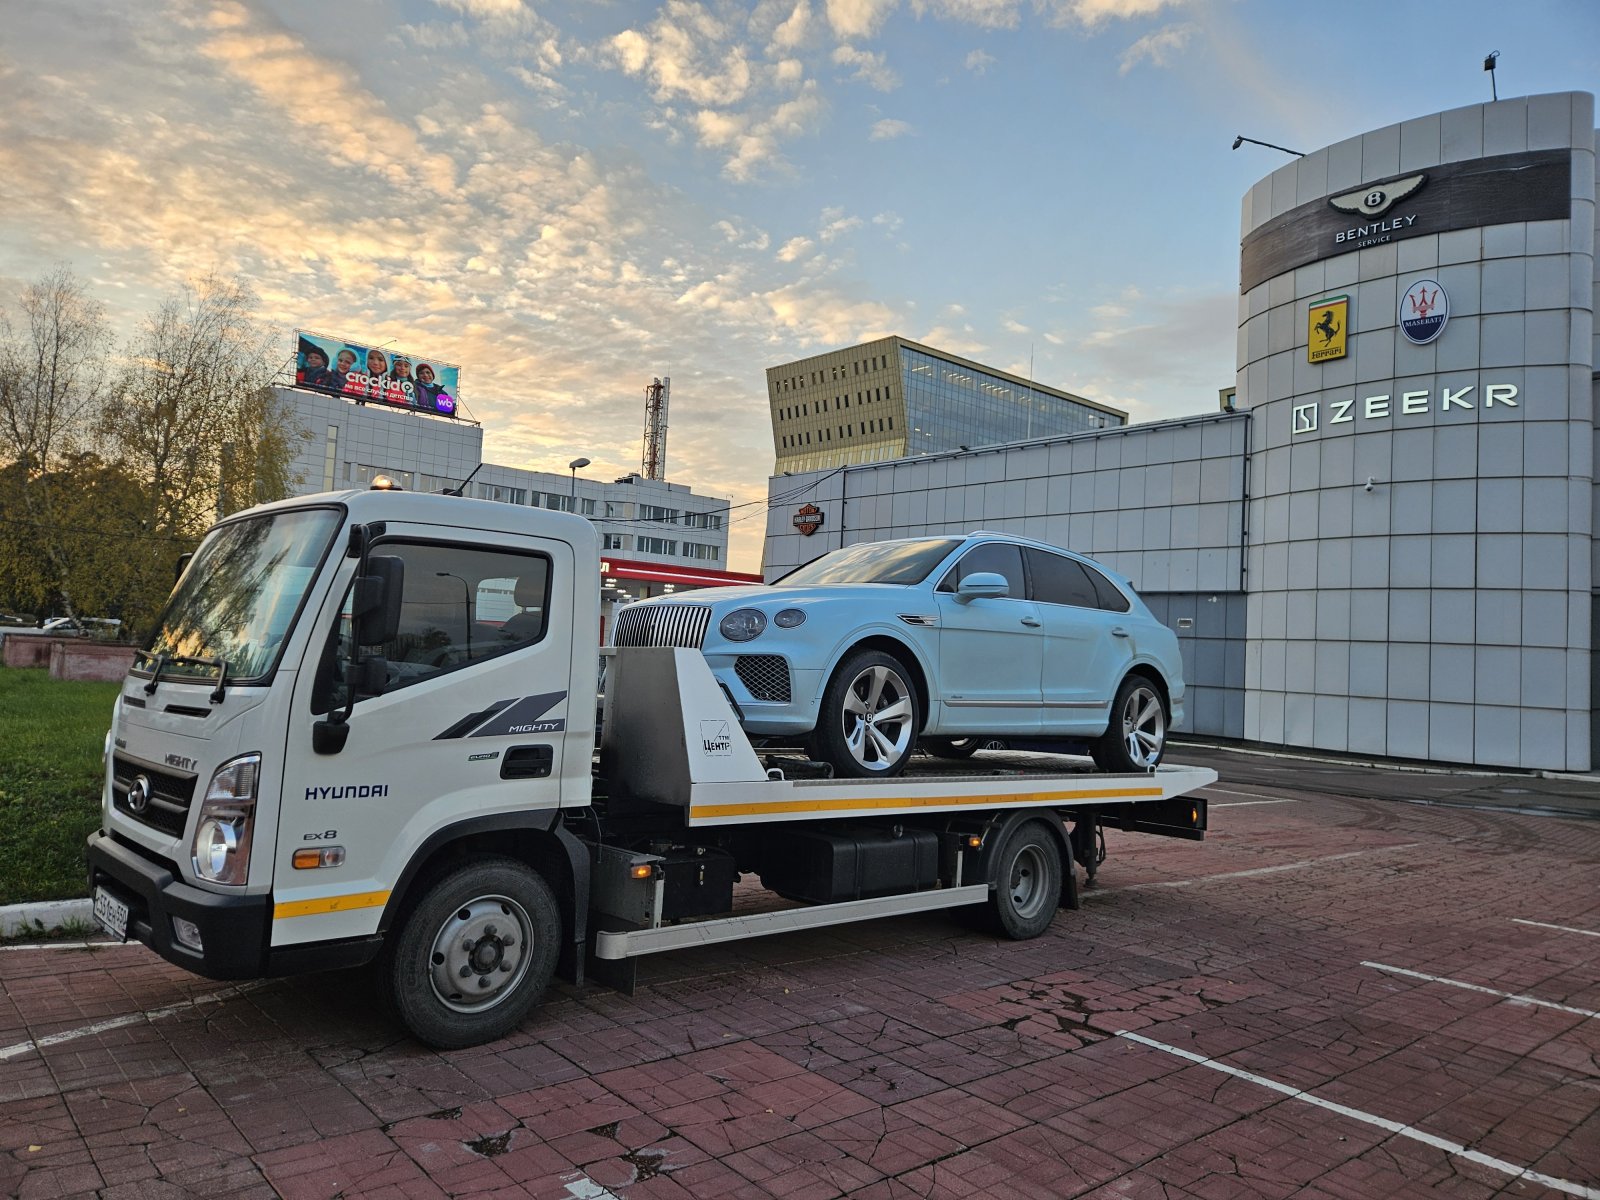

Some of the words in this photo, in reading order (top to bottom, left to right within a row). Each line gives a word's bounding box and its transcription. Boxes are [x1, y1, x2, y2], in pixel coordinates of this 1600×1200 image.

[1335, 214, 1418, 244] BENTLEY
[1357, 235, 1392, 248] SERVICE
[1405, 316, 1443, 328] MASERATI
[1311, 346, 1343, 360] Ferrari
[437, 397, 453, 409] wb
[1329, 383, 1519, 425] ZEEKR
[508, 722, 559, 733] MIGHTY
[304, 784, 389, 801] HYUNDAI
[303, 829, 338, 841] EX8
